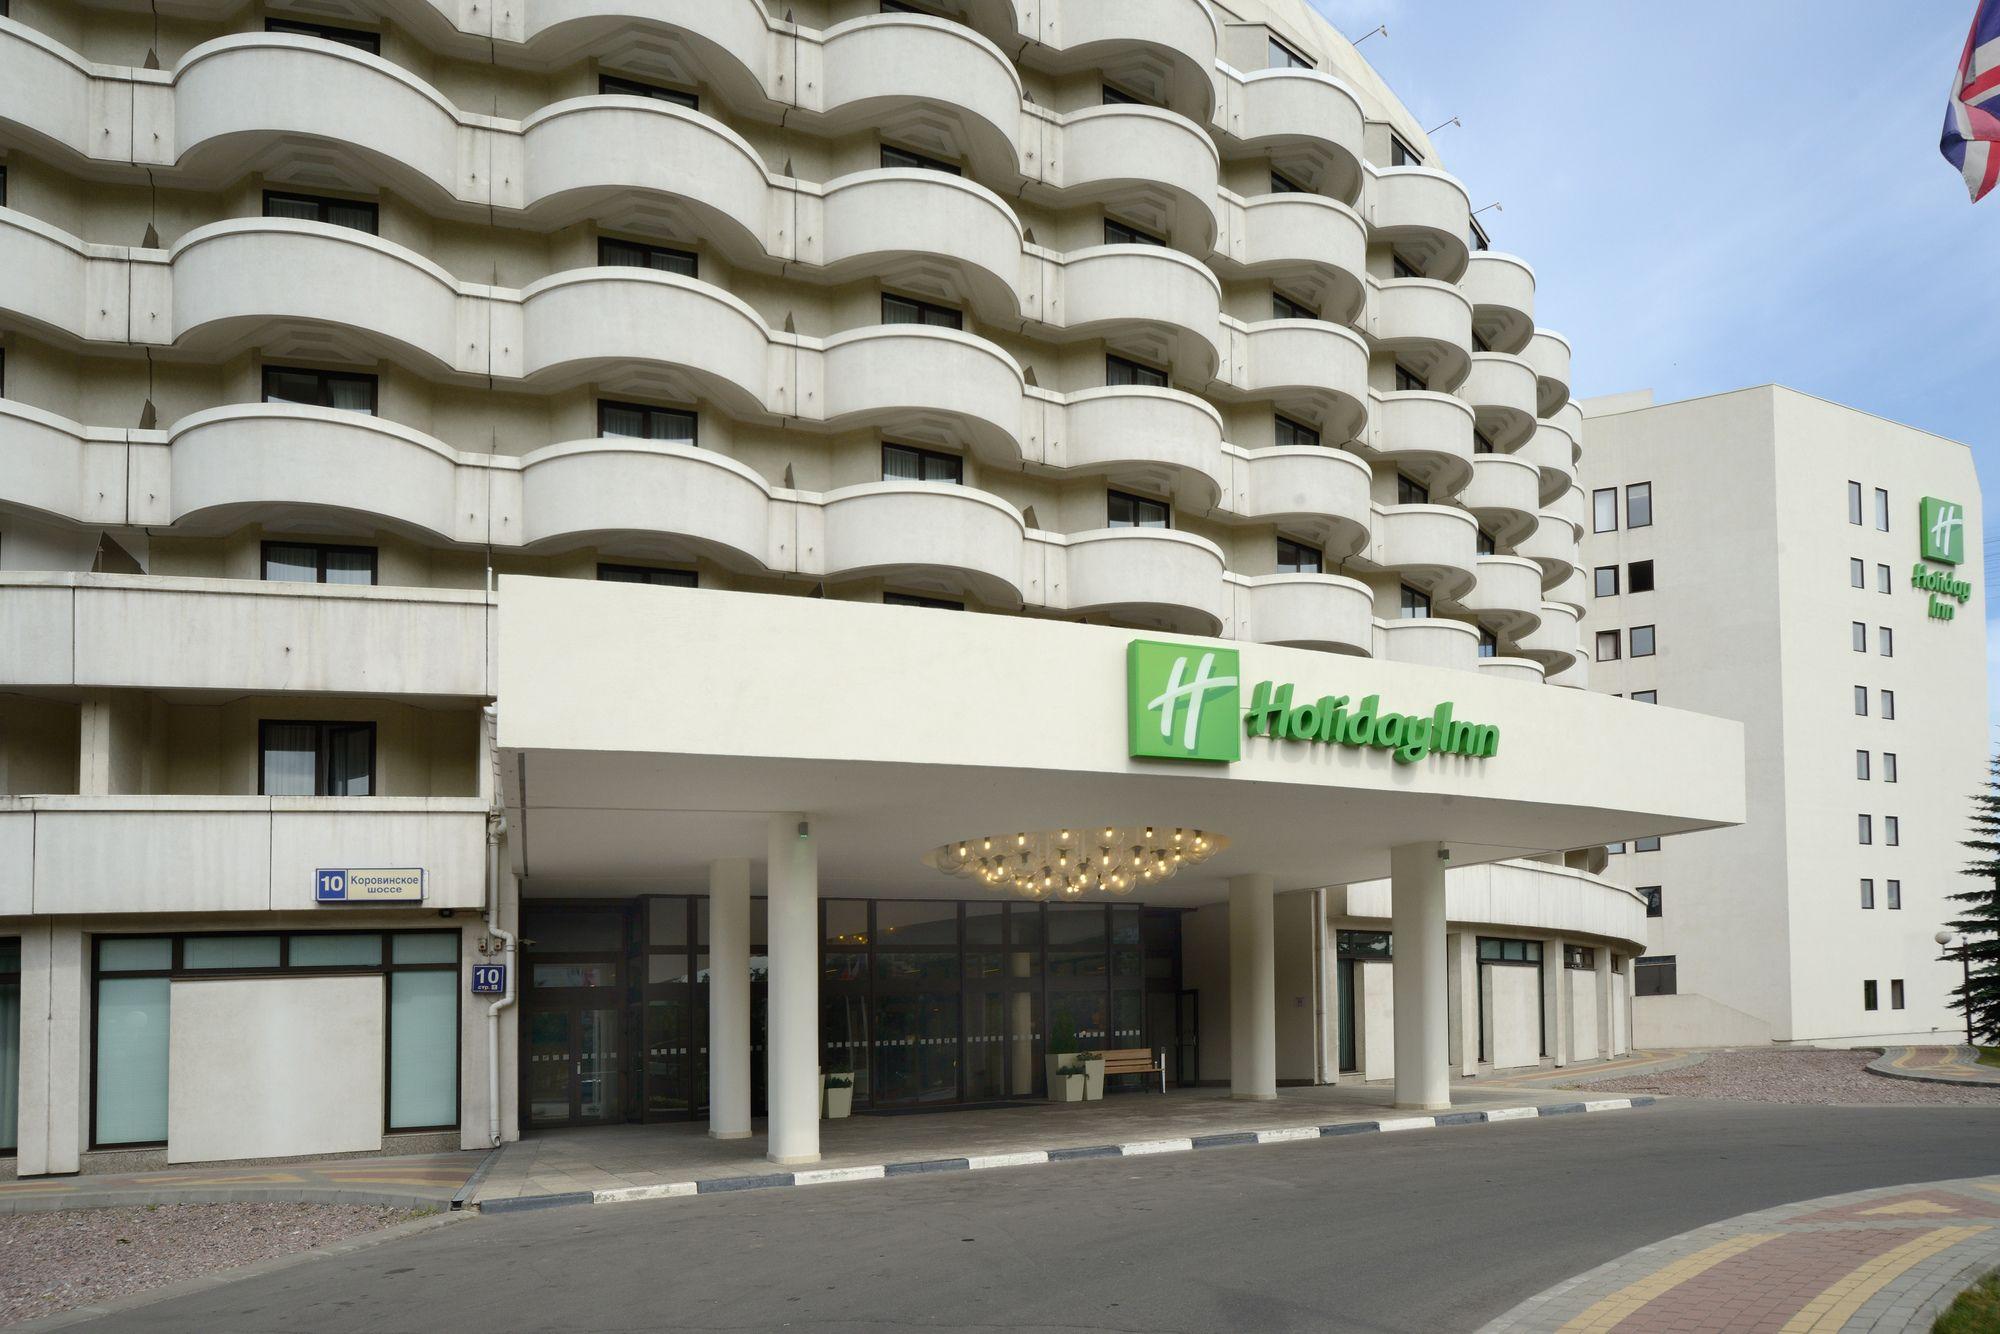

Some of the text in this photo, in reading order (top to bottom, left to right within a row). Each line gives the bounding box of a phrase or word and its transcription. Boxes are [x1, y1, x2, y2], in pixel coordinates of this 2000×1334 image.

[1912, 564, 1971, 603] Holiday
[1928, 594, 1954, 620] Inn
[1244, 681, 1500, 764] Holiday Inn
[321, 876, 343, 891] 10
[351, 876, 418, 886] Коровинское
[476, 969, 499, 984] 10
